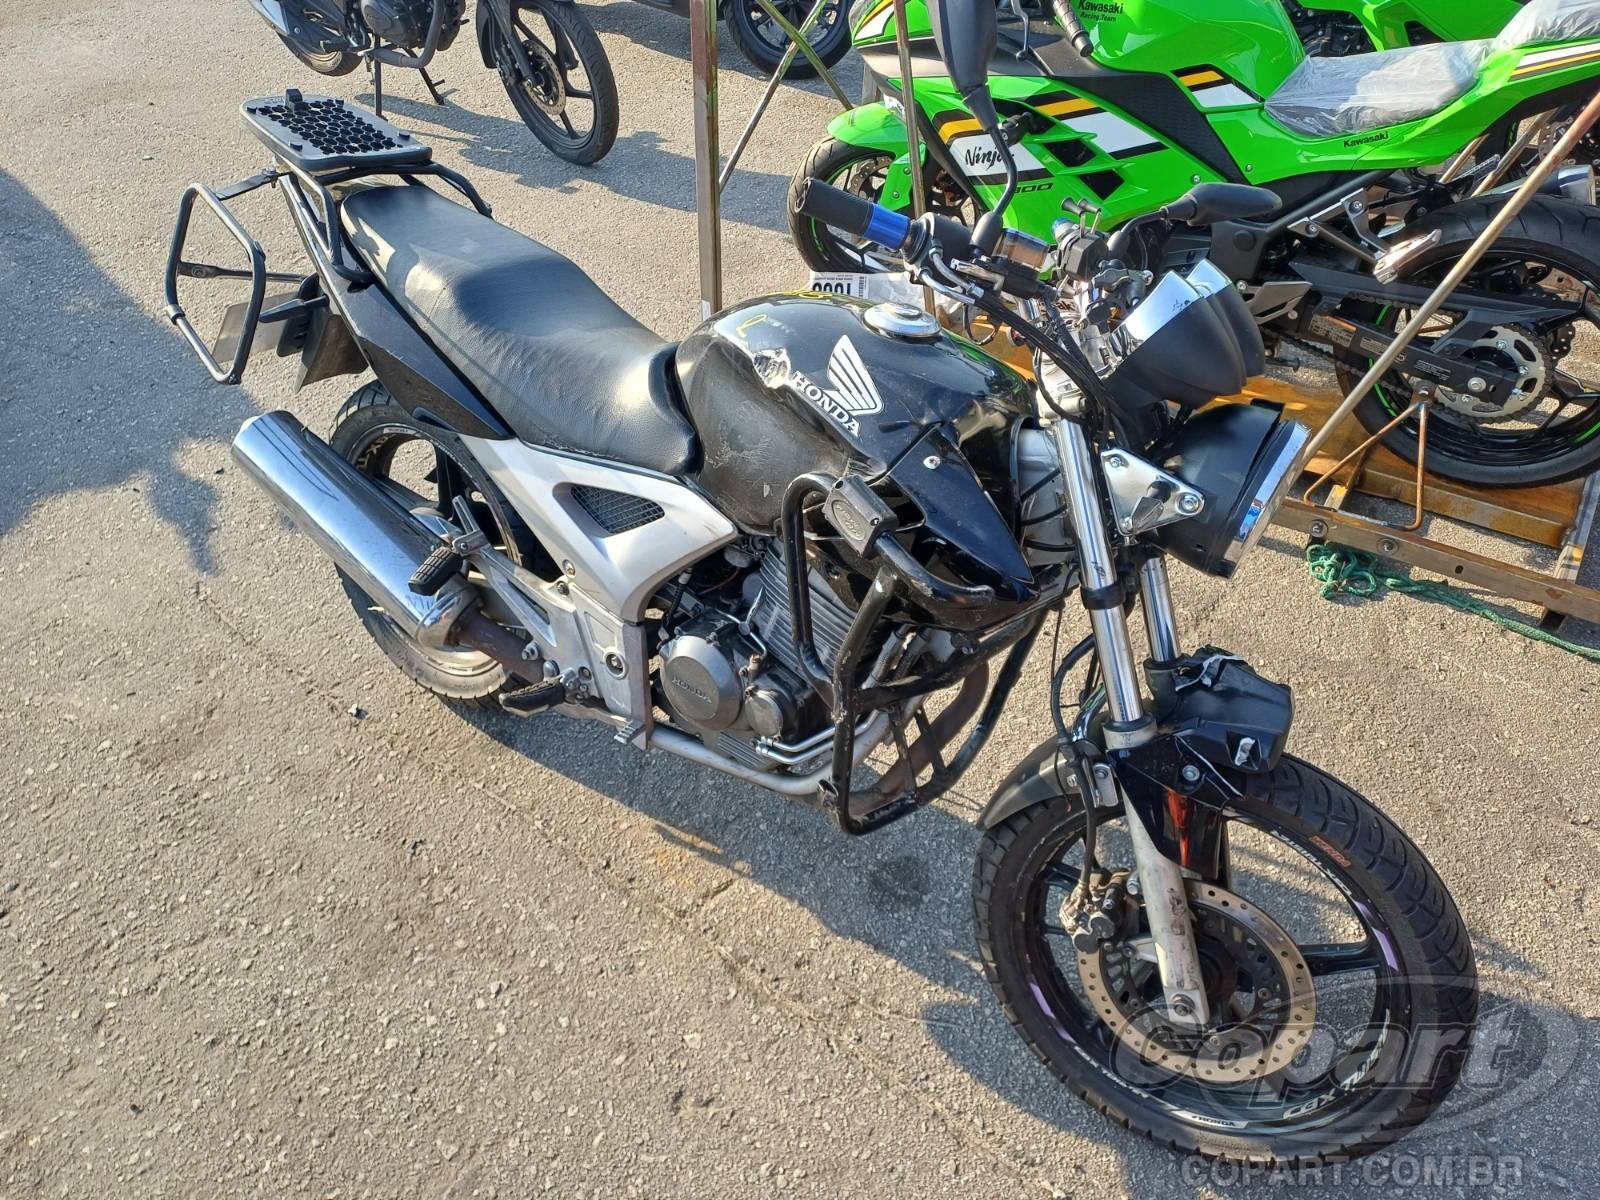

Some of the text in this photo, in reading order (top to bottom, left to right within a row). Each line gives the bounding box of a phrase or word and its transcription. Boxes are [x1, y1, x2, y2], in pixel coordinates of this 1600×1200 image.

[1078, 1, 1124, 14] Kawasaki
[1101, 14, 1117, 22] Team
[1343, 131, 1389, 148] Kawasaki
[791, 370, 861, 437] HONDA
